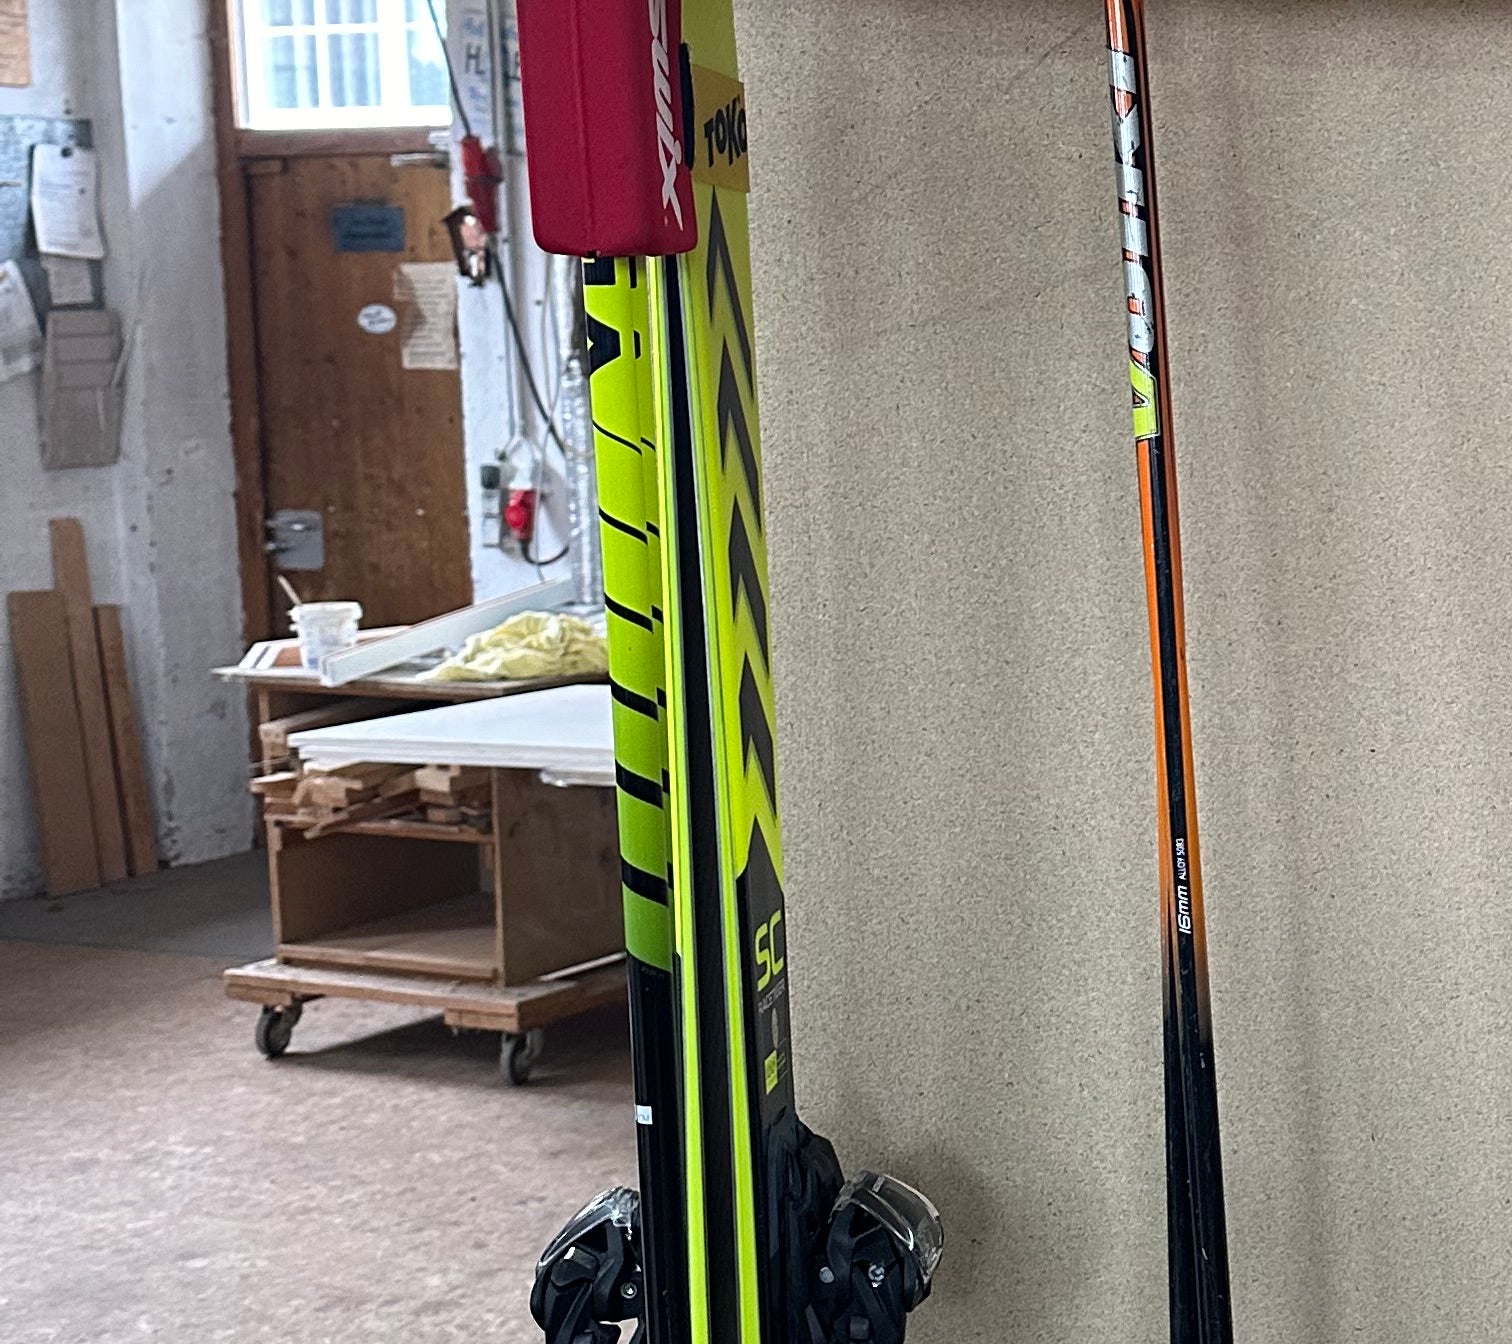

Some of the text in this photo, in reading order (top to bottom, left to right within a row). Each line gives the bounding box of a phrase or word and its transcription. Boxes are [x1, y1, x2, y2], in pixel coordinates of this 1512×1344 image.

[1176, 857, 1187, 881] ALLOY
[1177, 884, 1192, 935] 16mm
[754, 908, 785, 993] SC
